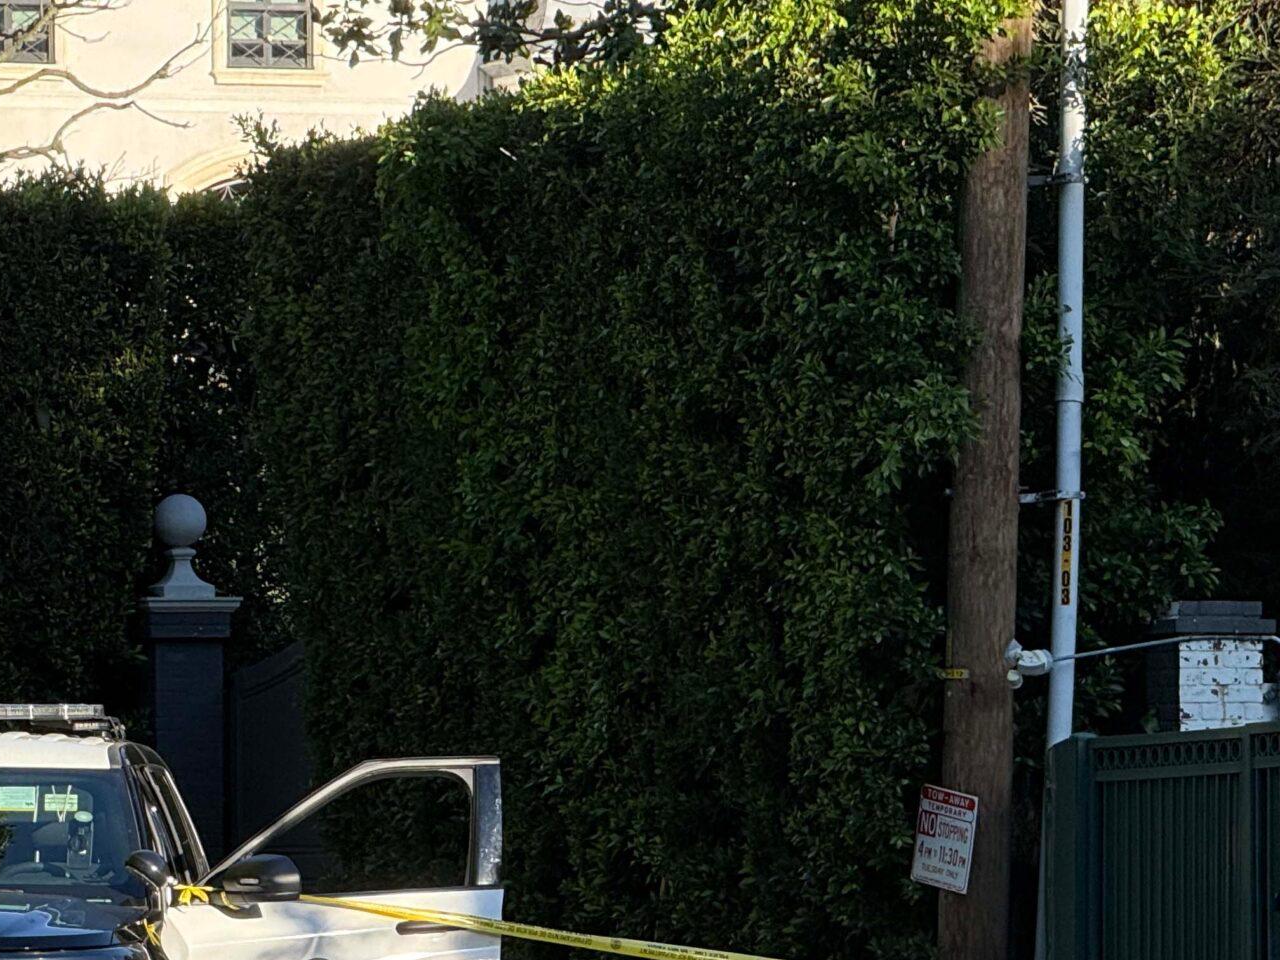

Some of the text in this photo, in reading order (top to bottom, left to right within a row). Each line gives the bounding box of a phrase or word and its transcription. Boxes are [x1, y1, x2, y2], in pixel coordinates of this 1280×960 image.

[927, 788, 970, 808] TOW-AWAY
[928, 802, 967, 817] TEMPORARY
[920, 811, 969, 844] NO STOPPING
[918, 840, 924, 857] 4
[938, 845, 959, 867] 11:30
